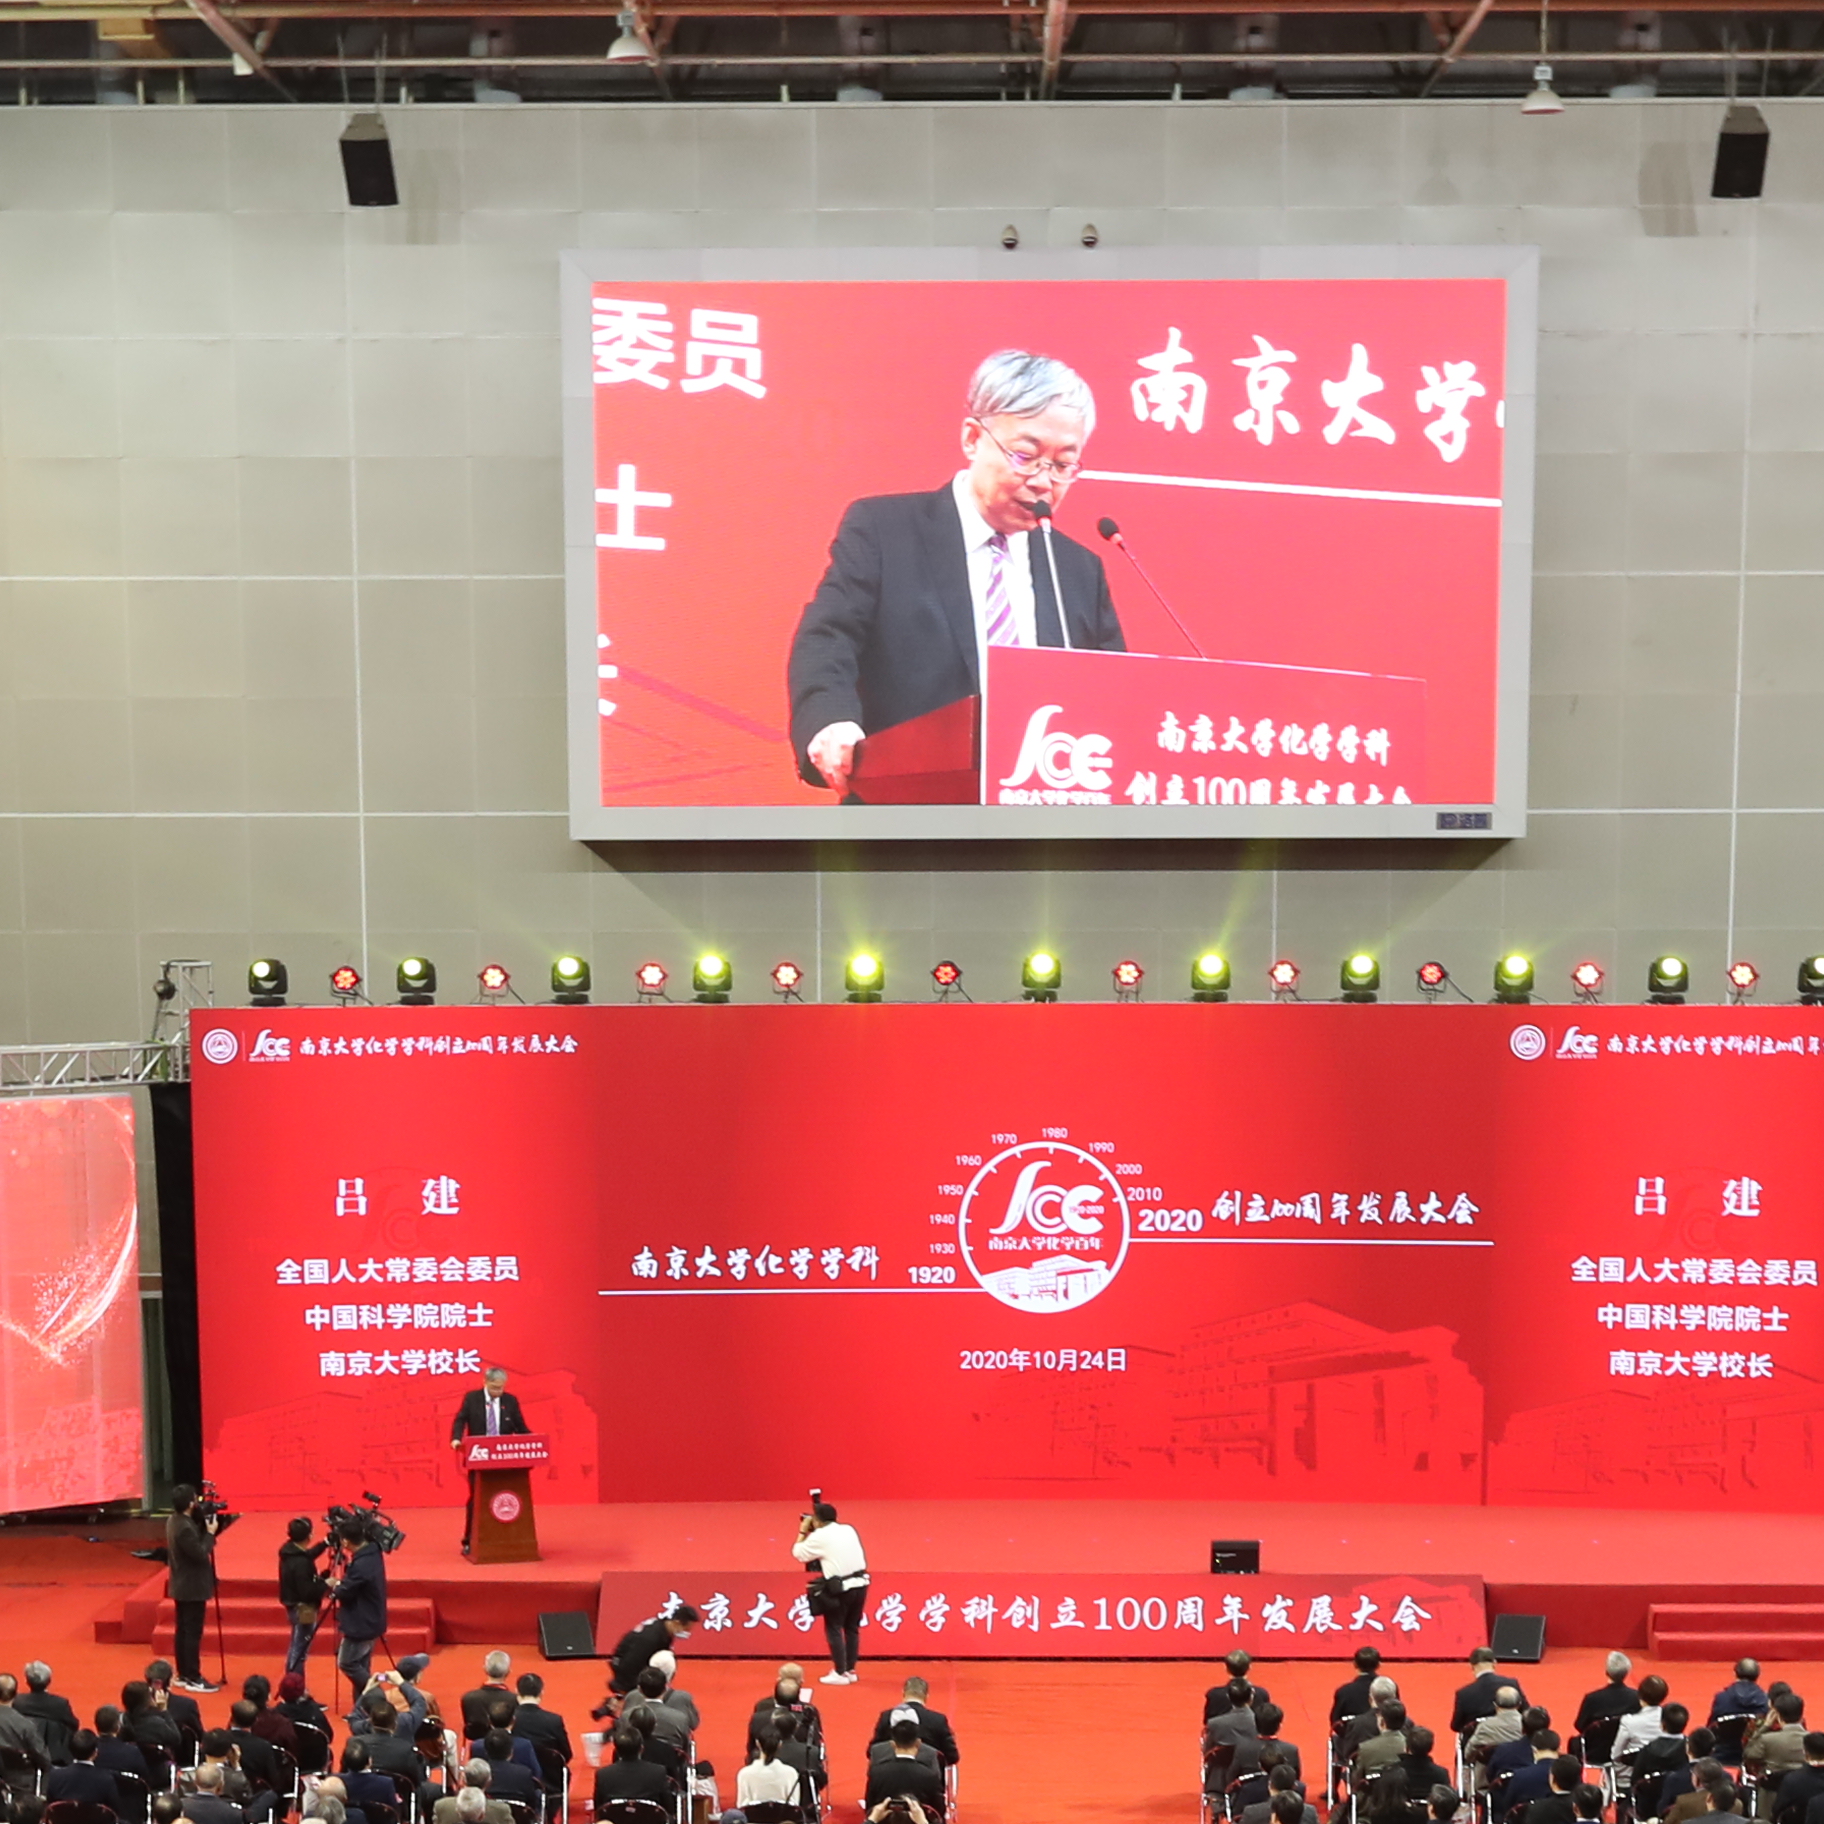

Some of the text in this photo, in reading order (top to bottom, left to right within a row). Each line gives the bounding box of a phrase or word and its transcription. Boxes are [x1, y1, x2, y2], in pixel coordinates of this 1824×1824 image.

[591, 298, 768, 400] 委员
[1129, 326, 1505, 464] 南京大学
[595, 463, 673, 551] 士
[1156, 711, 1391, 767] 南京大学化学学科
[991, 1133, 1017, 1145] 1970
[1041, 1127, 1068, 1139] 1980
[955, 1155, 982, 1167] 1960
[1088, 1142, 1115, 1154] 1990
[1115, 1164, 1143, 1176] 2000
[937, 1184, 964, 1196] 1950
[1127, 1187, 1164, 1202] 2010
[929, 1213, 956, 1225] 1940
[1138, 1208, 1204, 1233] 2020
[1211, 1190, 1480, 1226] 创立100周年发展大会
[631, 1245, 880, 1281] 南京大学化学学科
[929, 1243, 956, 1255] 1930
[275, 1256, 519, 1285] 全国人大常委会委员
[907, 1266, 957, 1285] 1920
[1570, 1256, 1818, 1286] 全国人大常委会委员
[304, 1302, 494, 1331] 中国科学院院士
[1596, 1303, 1789, 1332] 中国科学院院士
[319, 1349, 481, 1377] 南京大学校长
[960, 1348, 1127, 1372] 2020年10月24日
[1608, 1349, 1774, 1378] 南京大学校长
[658, 1591, 1432, 1635] 京大学学学科创立100周年发展大会
